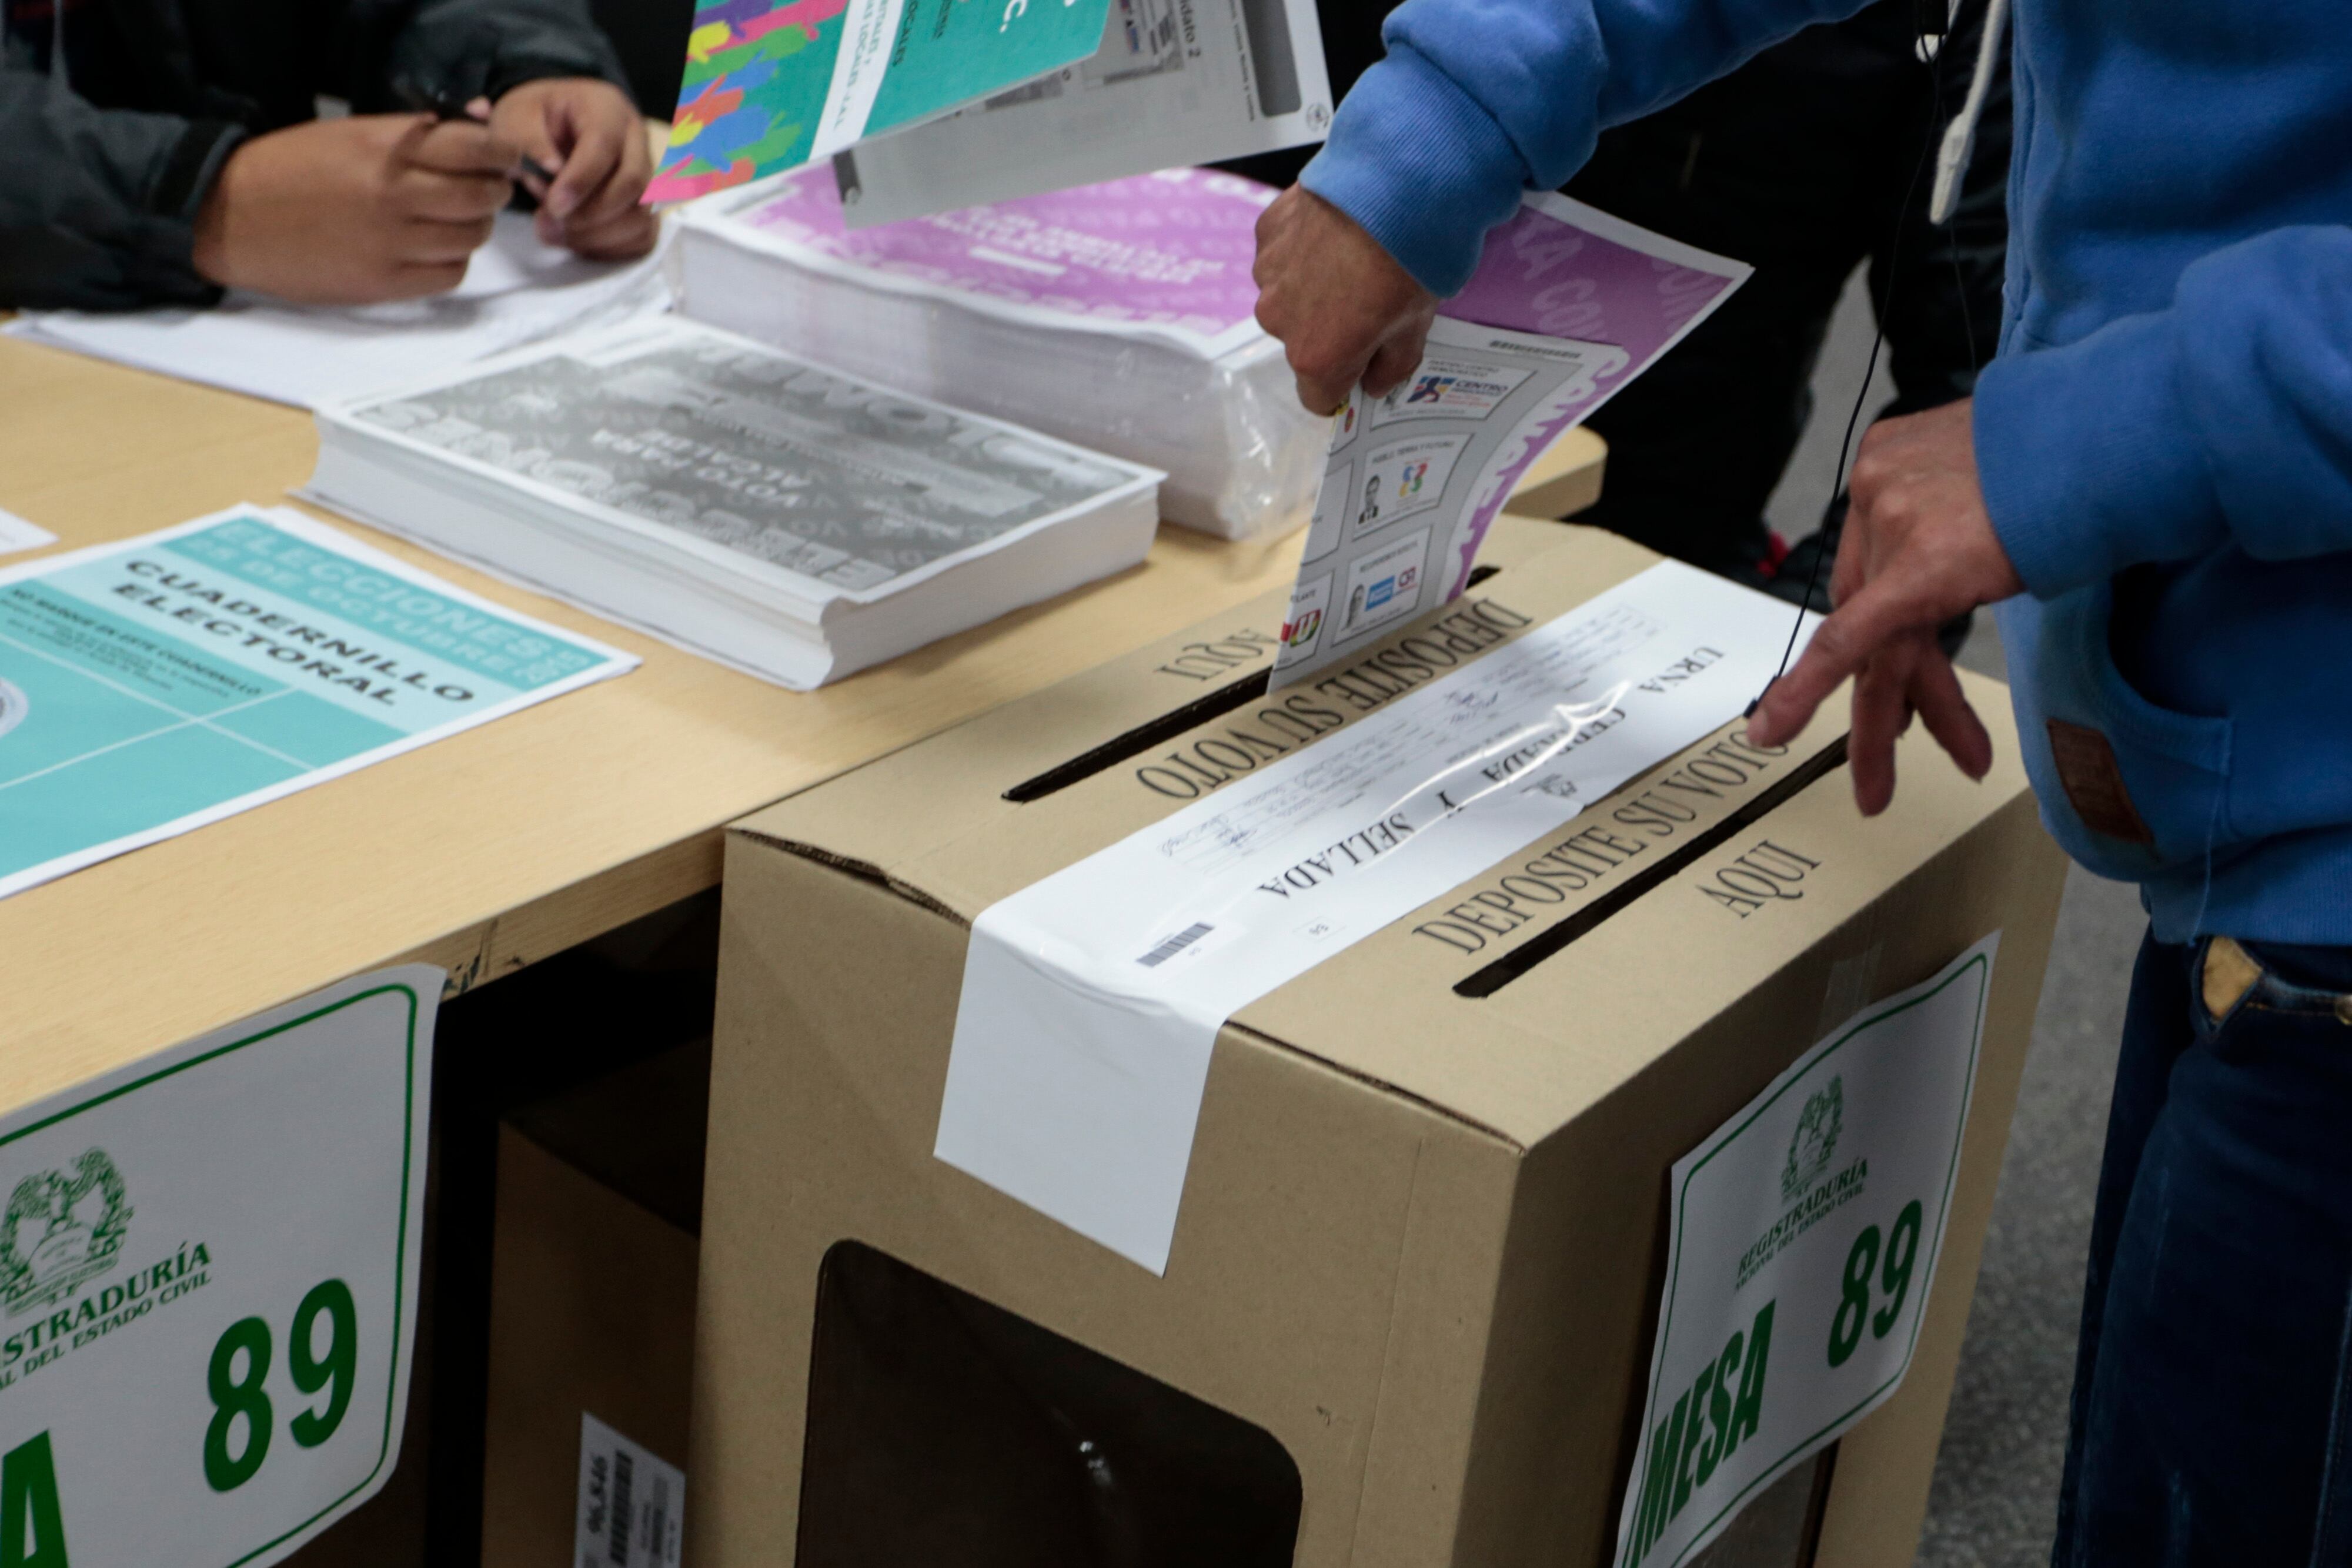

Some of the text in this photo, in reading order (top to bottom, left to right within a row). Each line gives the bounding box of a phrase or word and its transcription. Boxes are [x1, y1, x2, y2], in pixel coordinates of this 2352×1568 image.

[1455, 379, 1509, 392] CENTRO
[111, 583, 397, 706] ELECTORAL
[125, 559, 474, 702] CUADERNILLO
[1637, 646, 1725, 695] URNA
[1135, 597, 1534, 800] DEPOSITE SU VOTO
[1255, 811, 1416, 900] SELLADA
[1412, 825, 1647, 956] DEPOSITE
[1612, 790, 1698, 838] SU
[1696, 840, 1822, 920] AQUI
[1738, 1156, 1869, 1278] REGISTRADURÍA
[24, 1343, 65, 1376] DEL
[73, 1298, 154, 1350] ESTADO
[159, 1271, 212, 1306] CIVIL
[1629, 1199, 1923, 1568] MESA 89
[203, 1277, 357, 1494] 89
